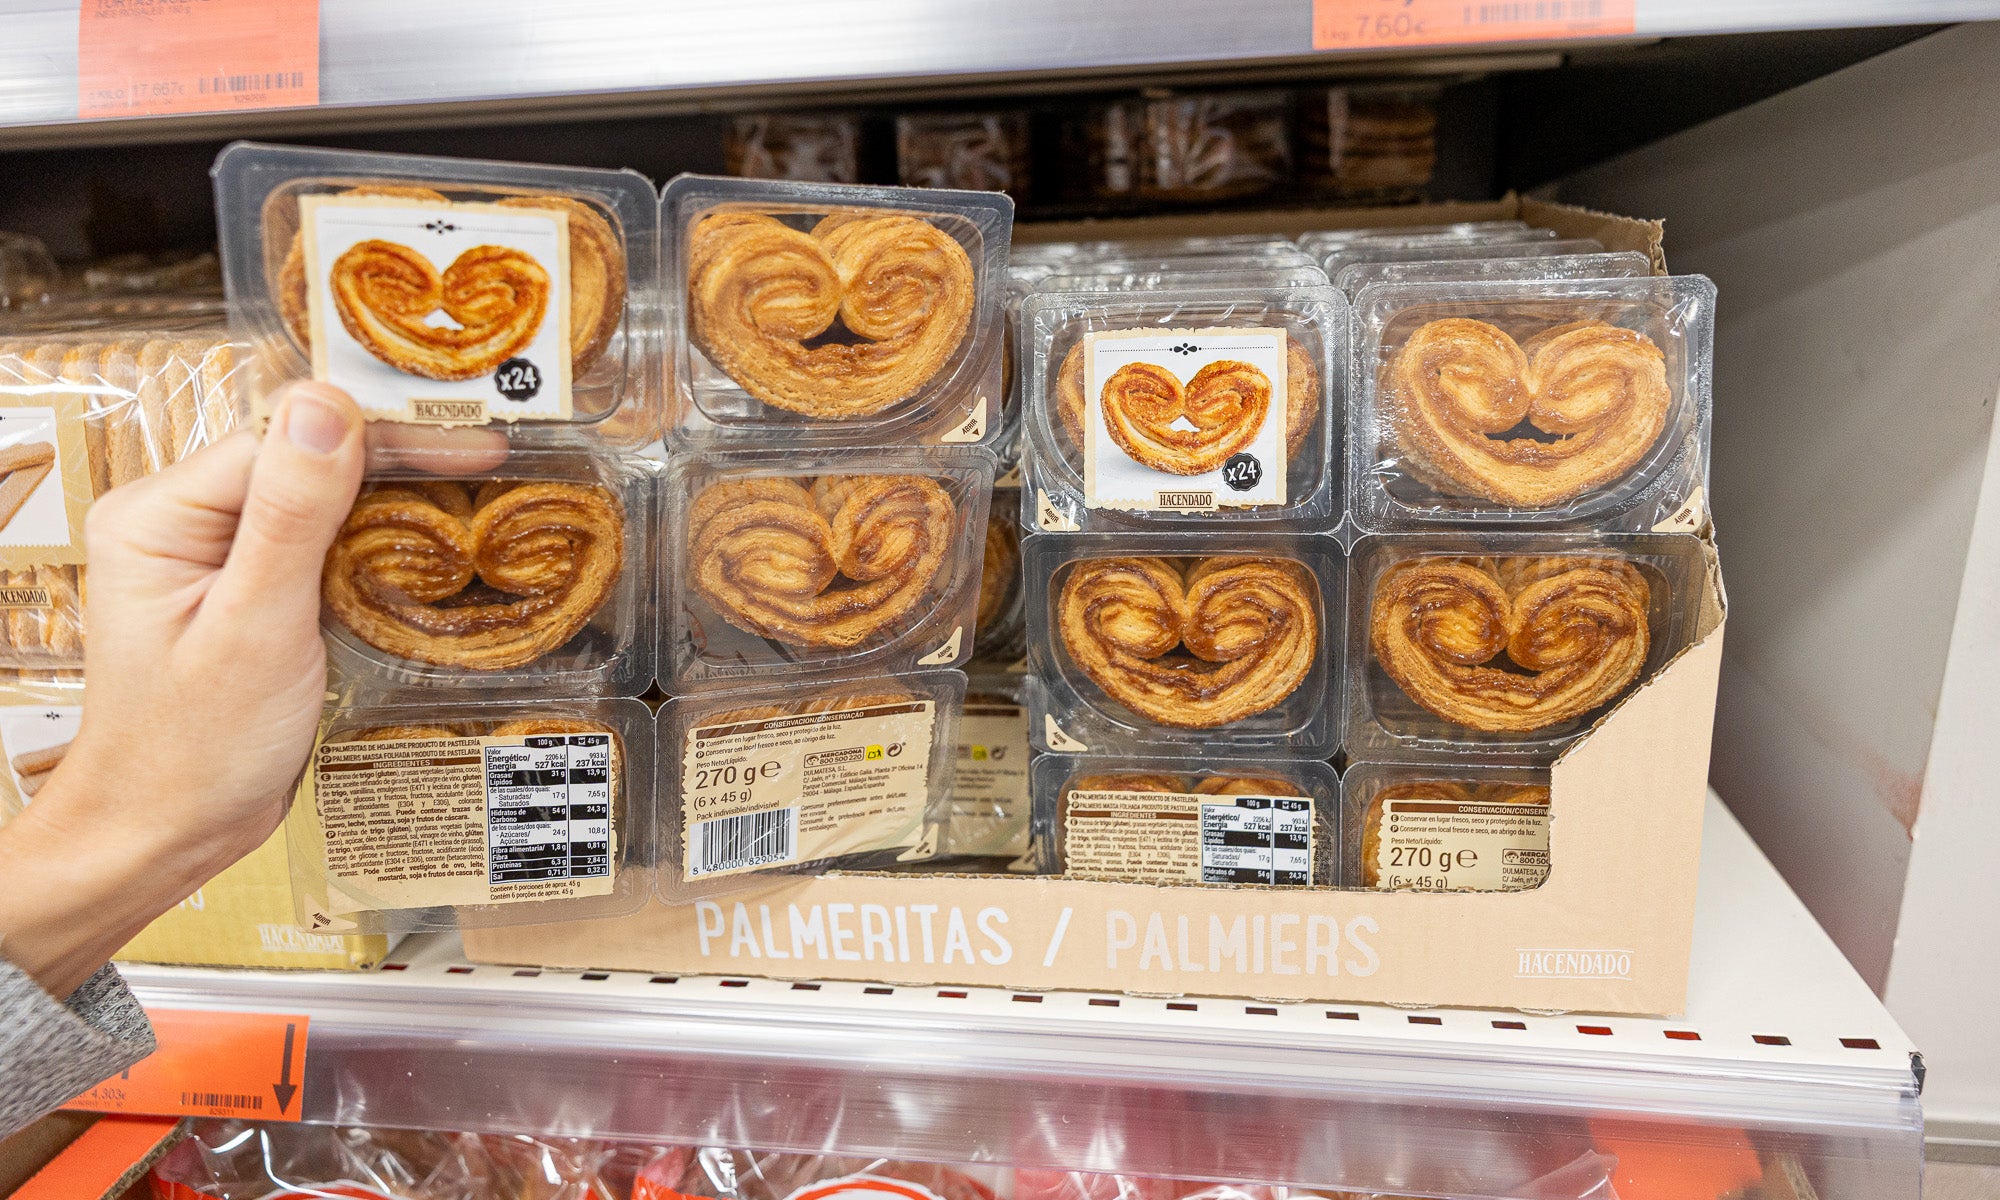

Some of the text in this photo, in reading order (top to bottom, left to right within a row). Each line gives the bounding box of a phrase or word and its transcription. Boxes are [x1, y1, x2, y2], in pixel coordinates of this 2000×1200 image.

[499, 367, 536, 391] x24
[416, 404, 482, 417] HACENDADO
[962, 419, 977, 435] ABRIR
[1228, 462, 1257, 482] x24
[1160, 495, 1212, 506] HACENDADO
[1044, 508, 1059, 523] ABRIR
[1675, 508, 1692, 524] ABRIR
[0, 590, 47, 603] ACENDADO
[332, 744, 367, 752] PALMERITAS
[377, 742, 407, 750] HOJALDRE
[447, 738, 480, 747] PASTELERÍA
[333, 754, 361, 762] PALMIERS
[362, 752, 382, 760] MASSA
[384, 751, 410, 759] FOLHADA
[412, 750, 438, 758] PRODUTO
[447, 748, 480, 756] PASTELARIA
[488, 754, 530, 762] Energético/
[820, 749, 862, 758] MERCADONA
[373, 760, 431, 768] INGREDIENTES
[696, 766, 756, 789] 270 g
[694, 789, 752, 810] (6 x 45 g)
[396, 806, 415, 815] Puede
[1459, 806, 1548, 816] CONSERVACIÓN/CONSERV
[397, 817, 410, 825] soja
[1436, 816, 1450, 824] lugar
[1490, 818, 1516, 827] protegido
[693, 853, 785, 875] 8 480000 829054
[1390, 847, 1451, 872] 270 g
[378, 874, 407, 882] mostarda,
[312, 913, 331, 925] ABRIR
[694, 901, 1380, 976] PALMERITAS / PALMIERS
[1518, 953, 1631, 975] HACENDADO
